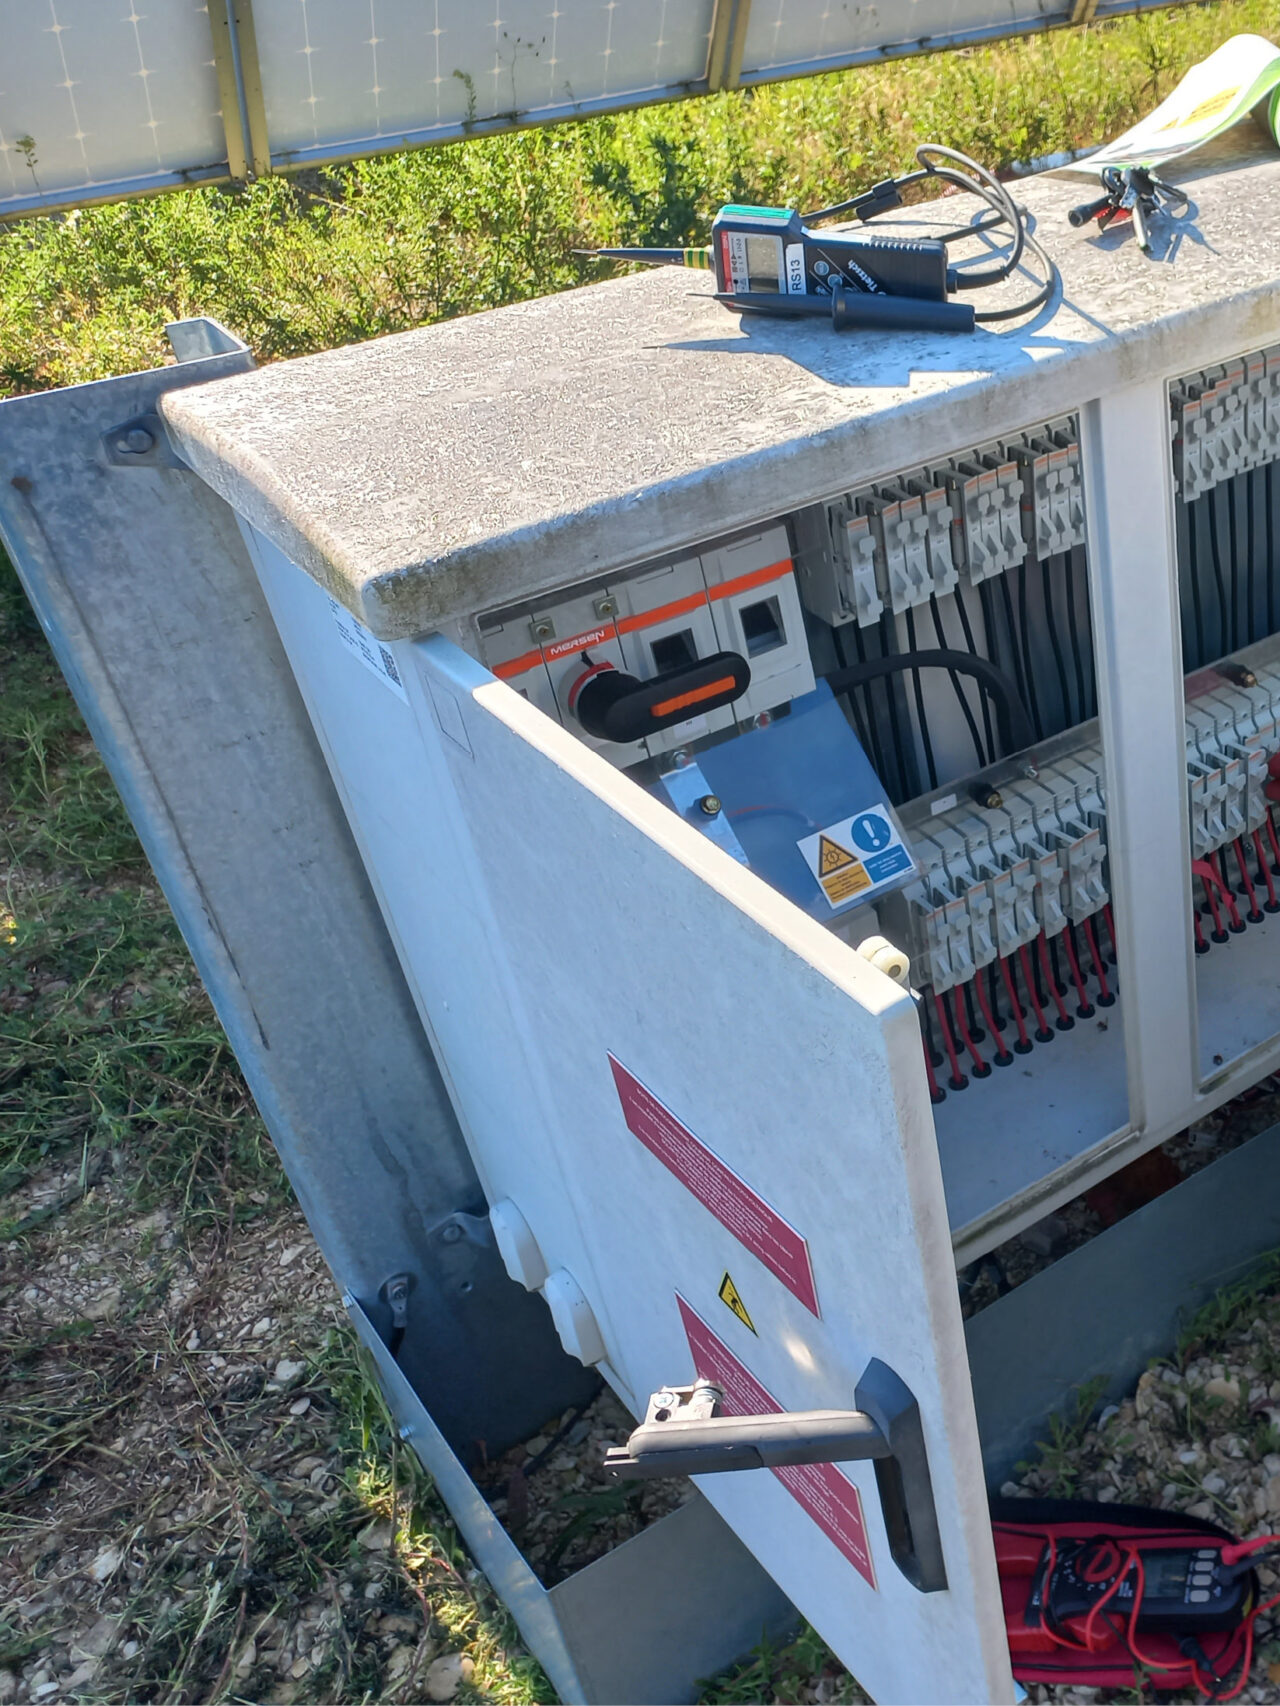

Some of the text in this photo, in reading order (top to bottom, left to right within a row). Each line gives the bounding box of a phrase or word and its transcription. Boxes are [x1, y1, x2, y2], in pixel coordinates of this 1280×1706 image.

[790, 259, 801, 291] RS13
[847, 259, 878, 292] Tietzsch
[550, 630, 605, 655] MERSEN
